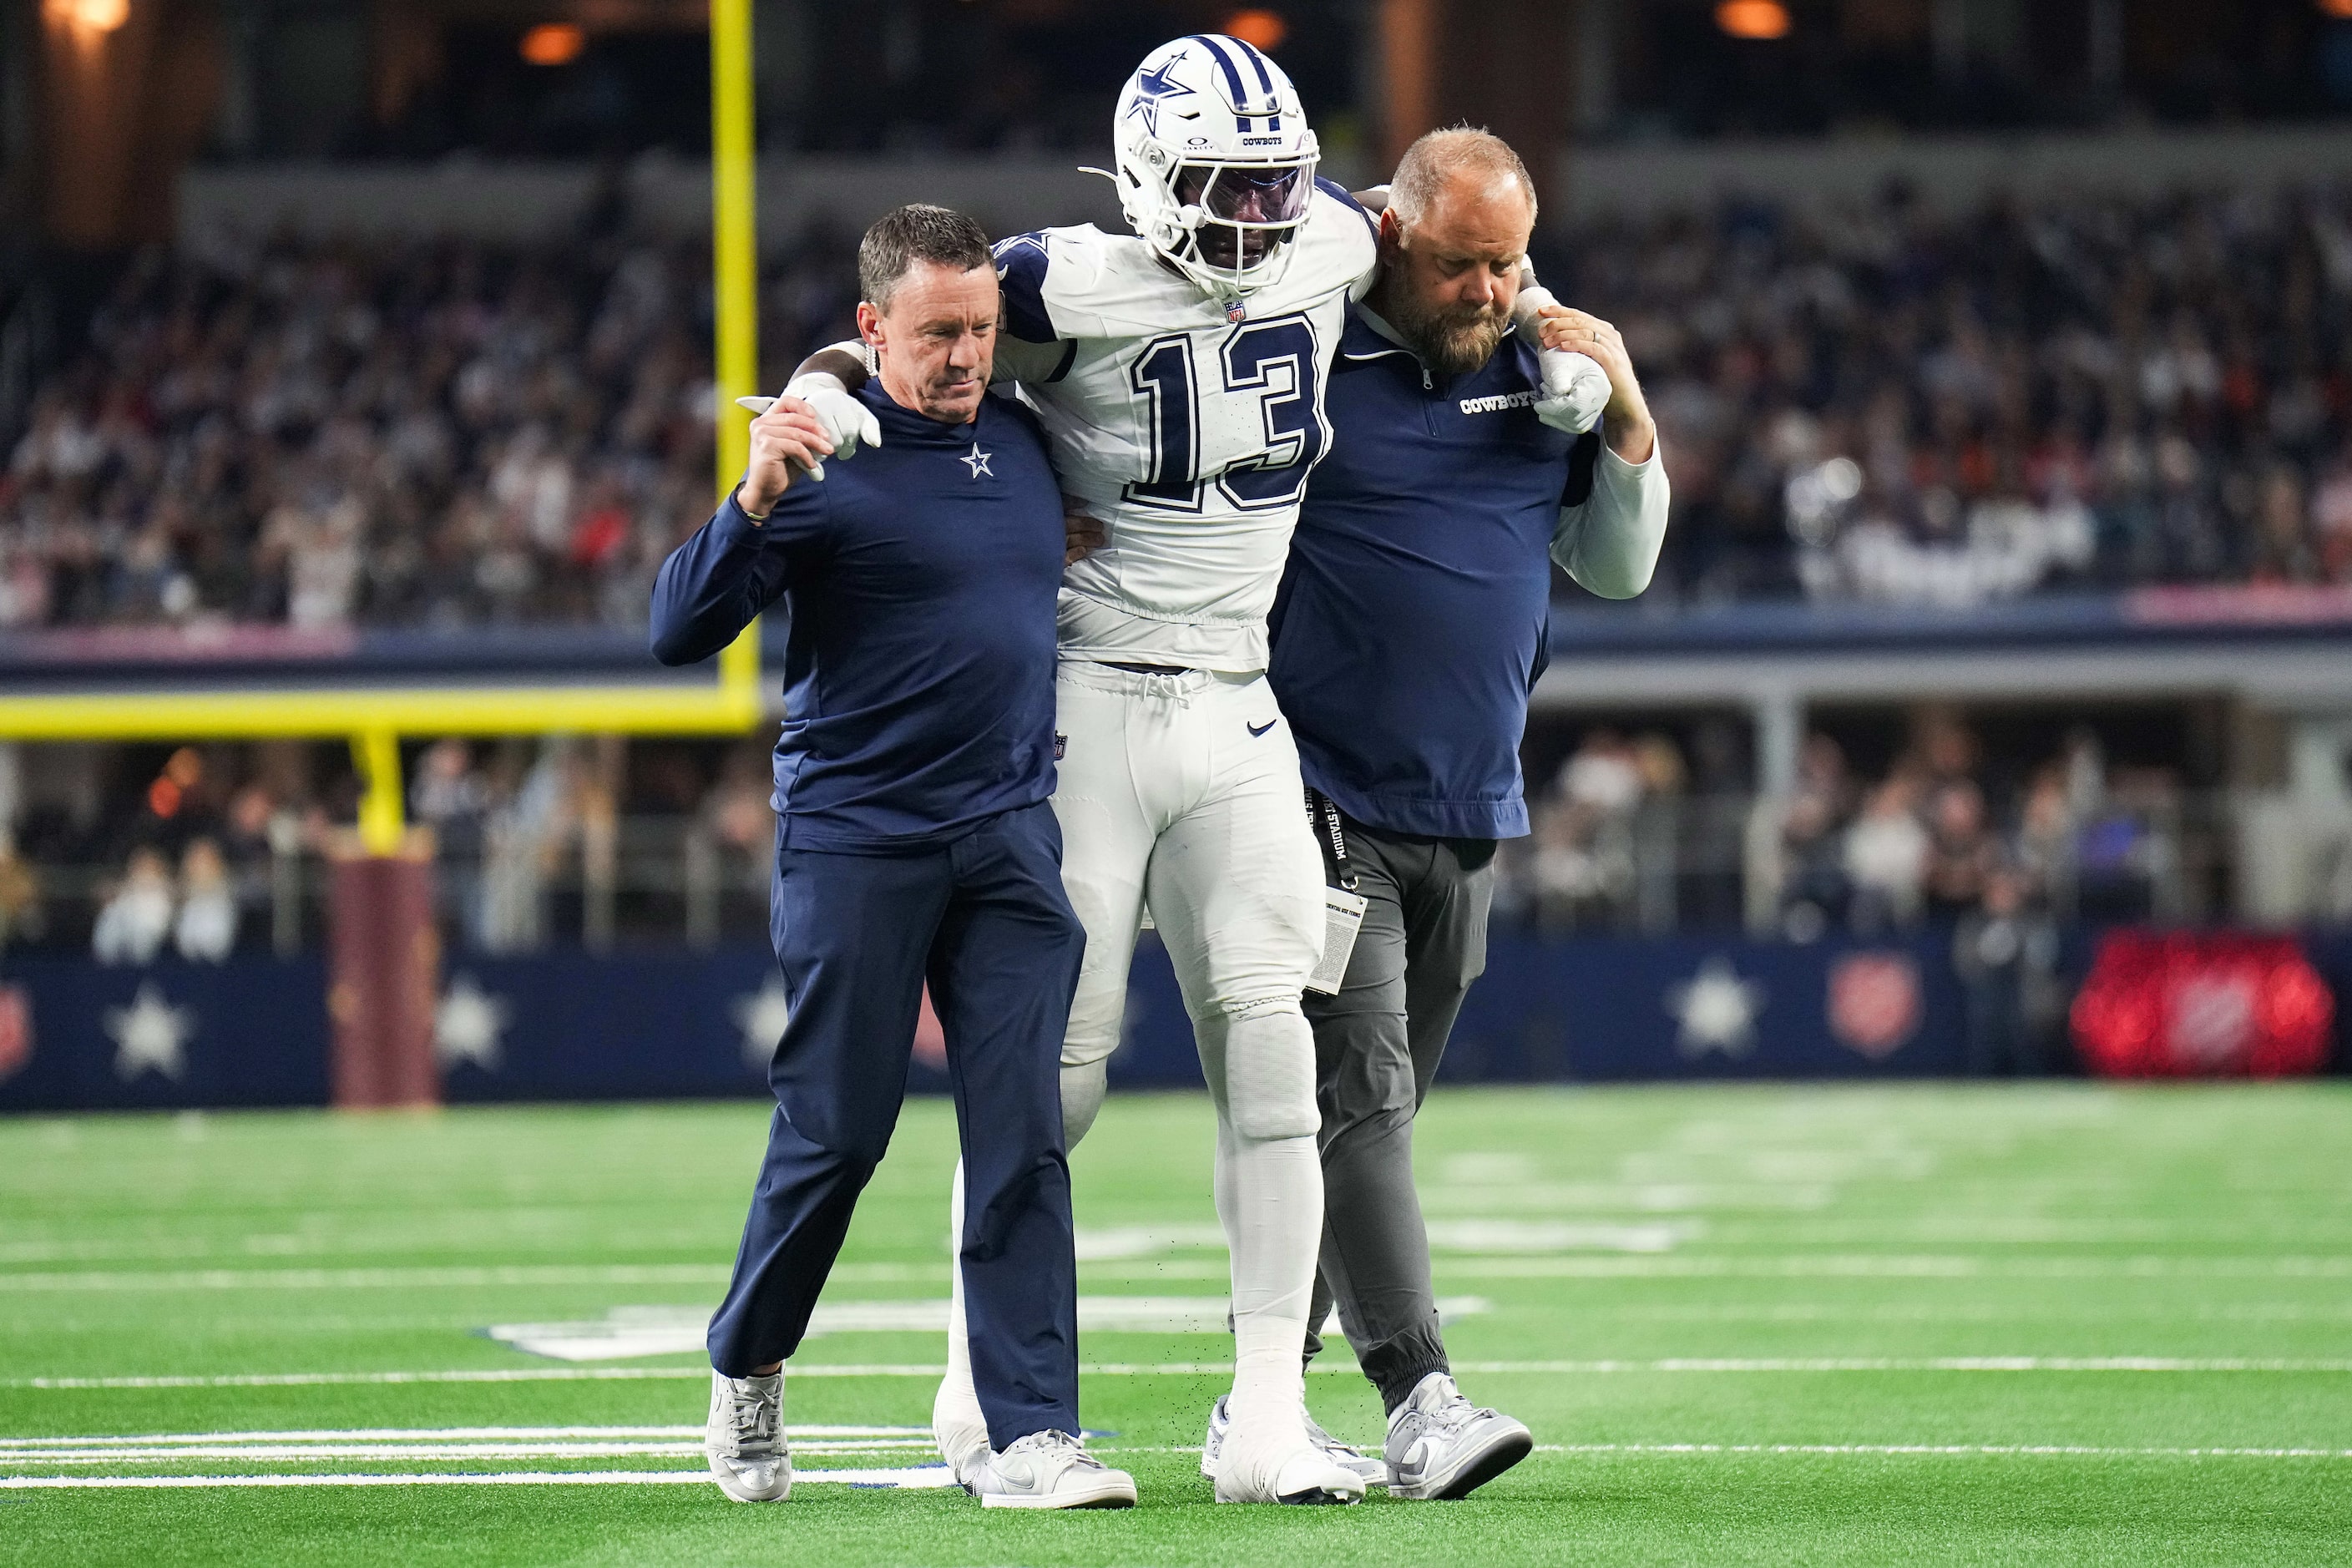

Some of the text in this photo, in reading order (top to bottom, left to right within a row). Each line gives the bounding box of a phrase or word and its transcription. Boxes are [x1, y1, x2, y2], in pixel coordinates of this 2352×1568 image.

[1242, 137, 1282, 146] COWBOYS
[1228, 309, 1244, 322] NFL
[1120, 311, 1326, 513] 13
[1459, 390, 1538, 415] COWBOYS
[1322, 796, 1347, 861] T&T STADIUM
